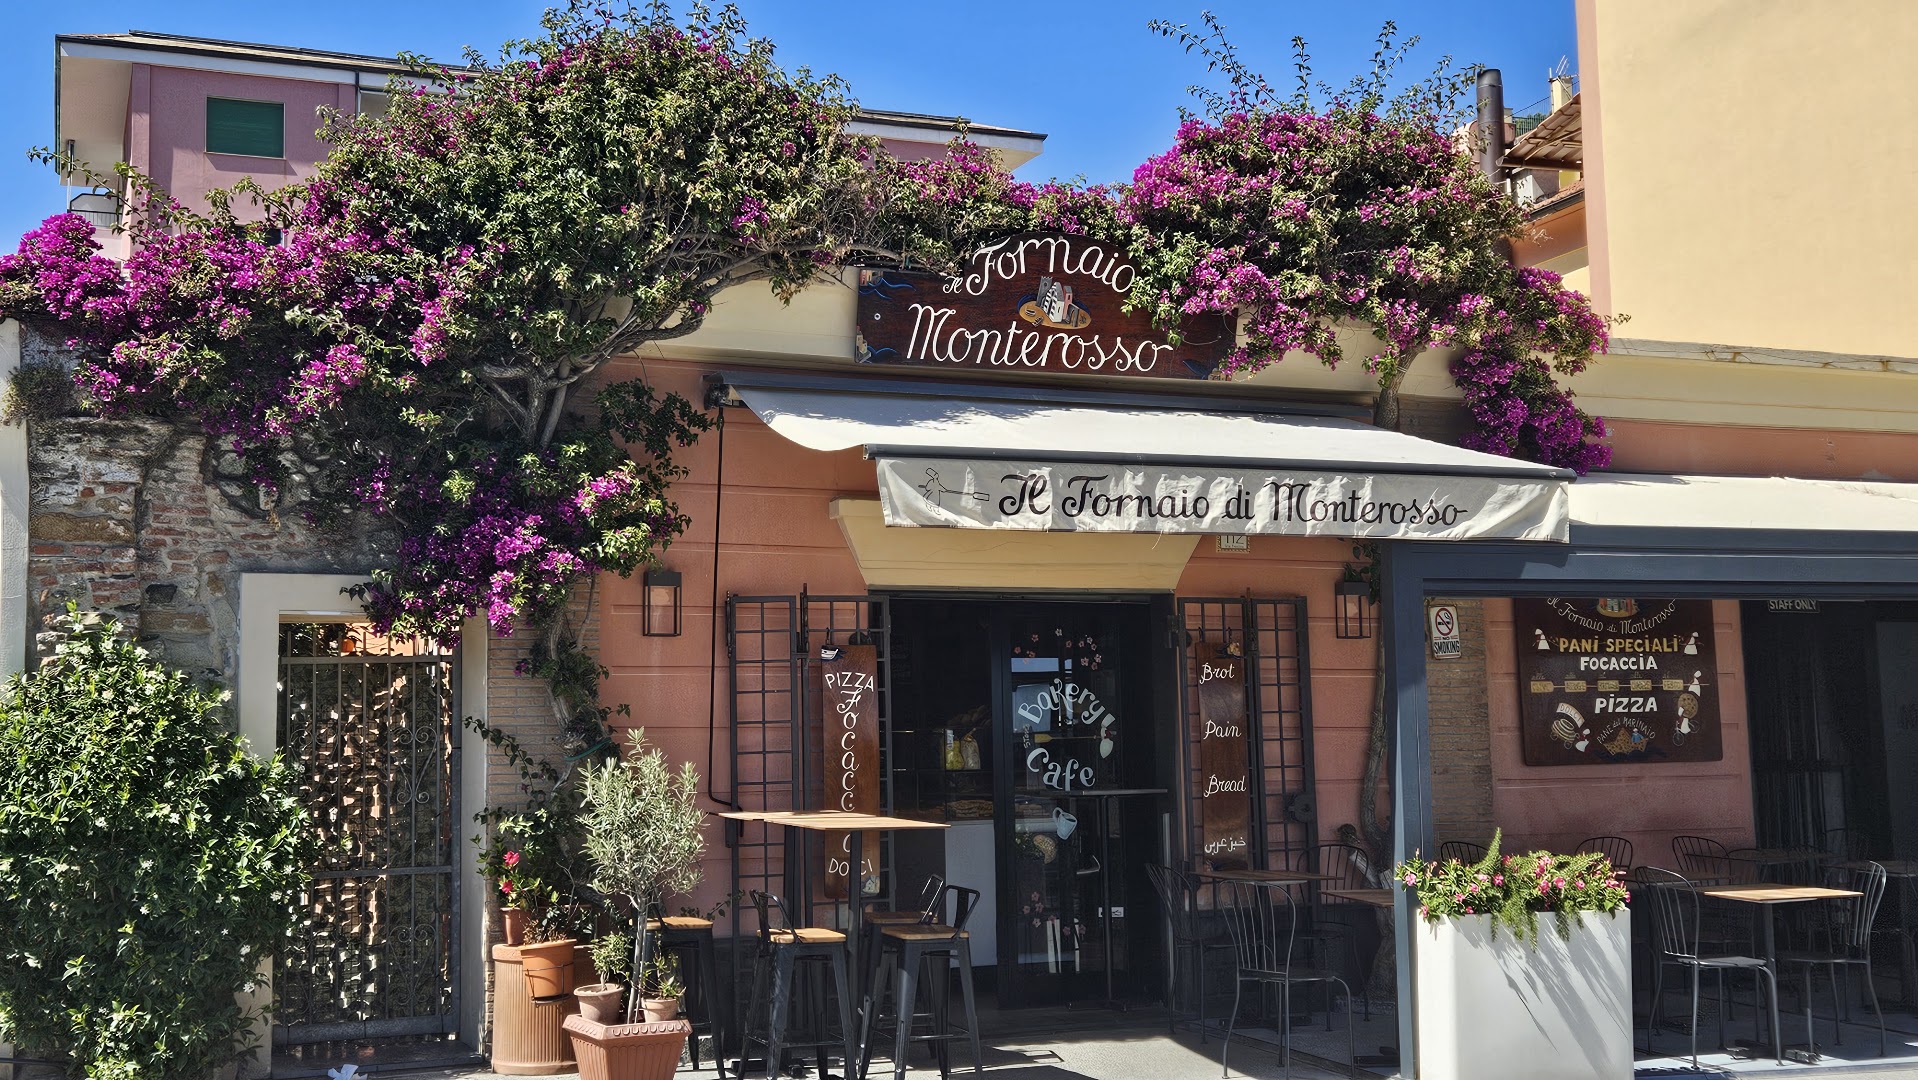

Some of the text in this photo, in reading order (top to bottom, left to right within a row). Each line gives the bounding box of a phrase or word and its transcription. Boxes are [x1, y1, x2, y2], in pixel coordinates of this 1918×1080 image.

[943, 237, 1137, 296] Il Fornaio
[906, 303, 1174, 372] Monterosso
[999, 473, 1468, 526] Il Fornaio di Monterosso
[1769, 598, 1817, 610] STAFF ONLY
[1558, 602, 1604, 632] Fornaio
[1607, 624, 1618, 633] di
[1619, 598, 1676, 634] Monterosso
[1434, 640, 1460, 655] SMOKING
[1199, 662, 1235, 684] Brot
[1580, 653, 1658, 671] FOCACCIA
[825, 671, 874, 692] PIZZA
[1017, 678, 1105, 725] Bakery
[1560, 703, 1583, 722] DOLCI
[1594, 693, 1658, 714] PIZZA
[1203, 719, 1242, 740] Pain
[1596, 724, 1614, 745] PANE
[1622, 716, 1656, 739] MARINAIO
[1026, 747, 1095, 791] Cafe
[1204, 774, 1247, 798] Bread
[1227, 836, 1247, 852] خبز
